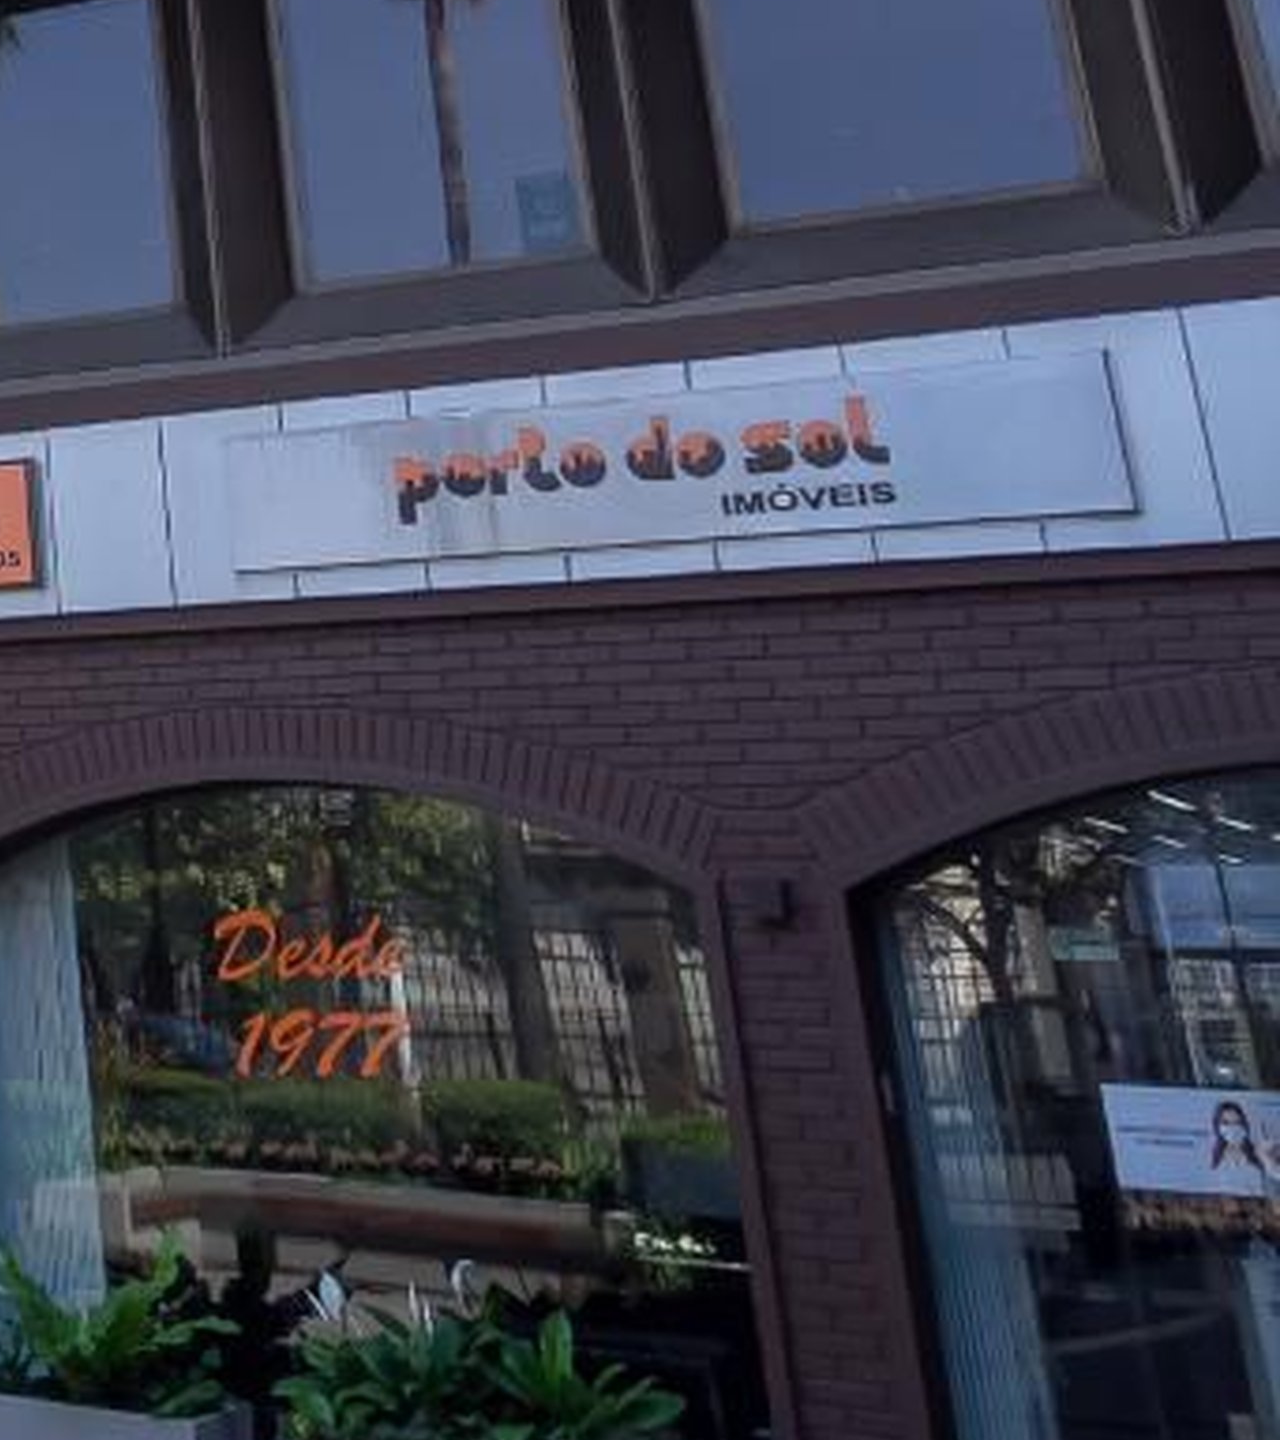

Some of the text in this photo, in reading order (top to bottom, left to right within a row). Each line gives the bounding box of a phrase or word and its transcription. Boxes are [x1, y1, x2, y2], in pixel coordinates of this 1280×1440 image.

[393, 392, 891, 524] porto do sol
[720, 481, 896, 517] IMÓVEIS
[214, 908, 403, 981] Desde
[237, 1009, 410, 1078] 1977
